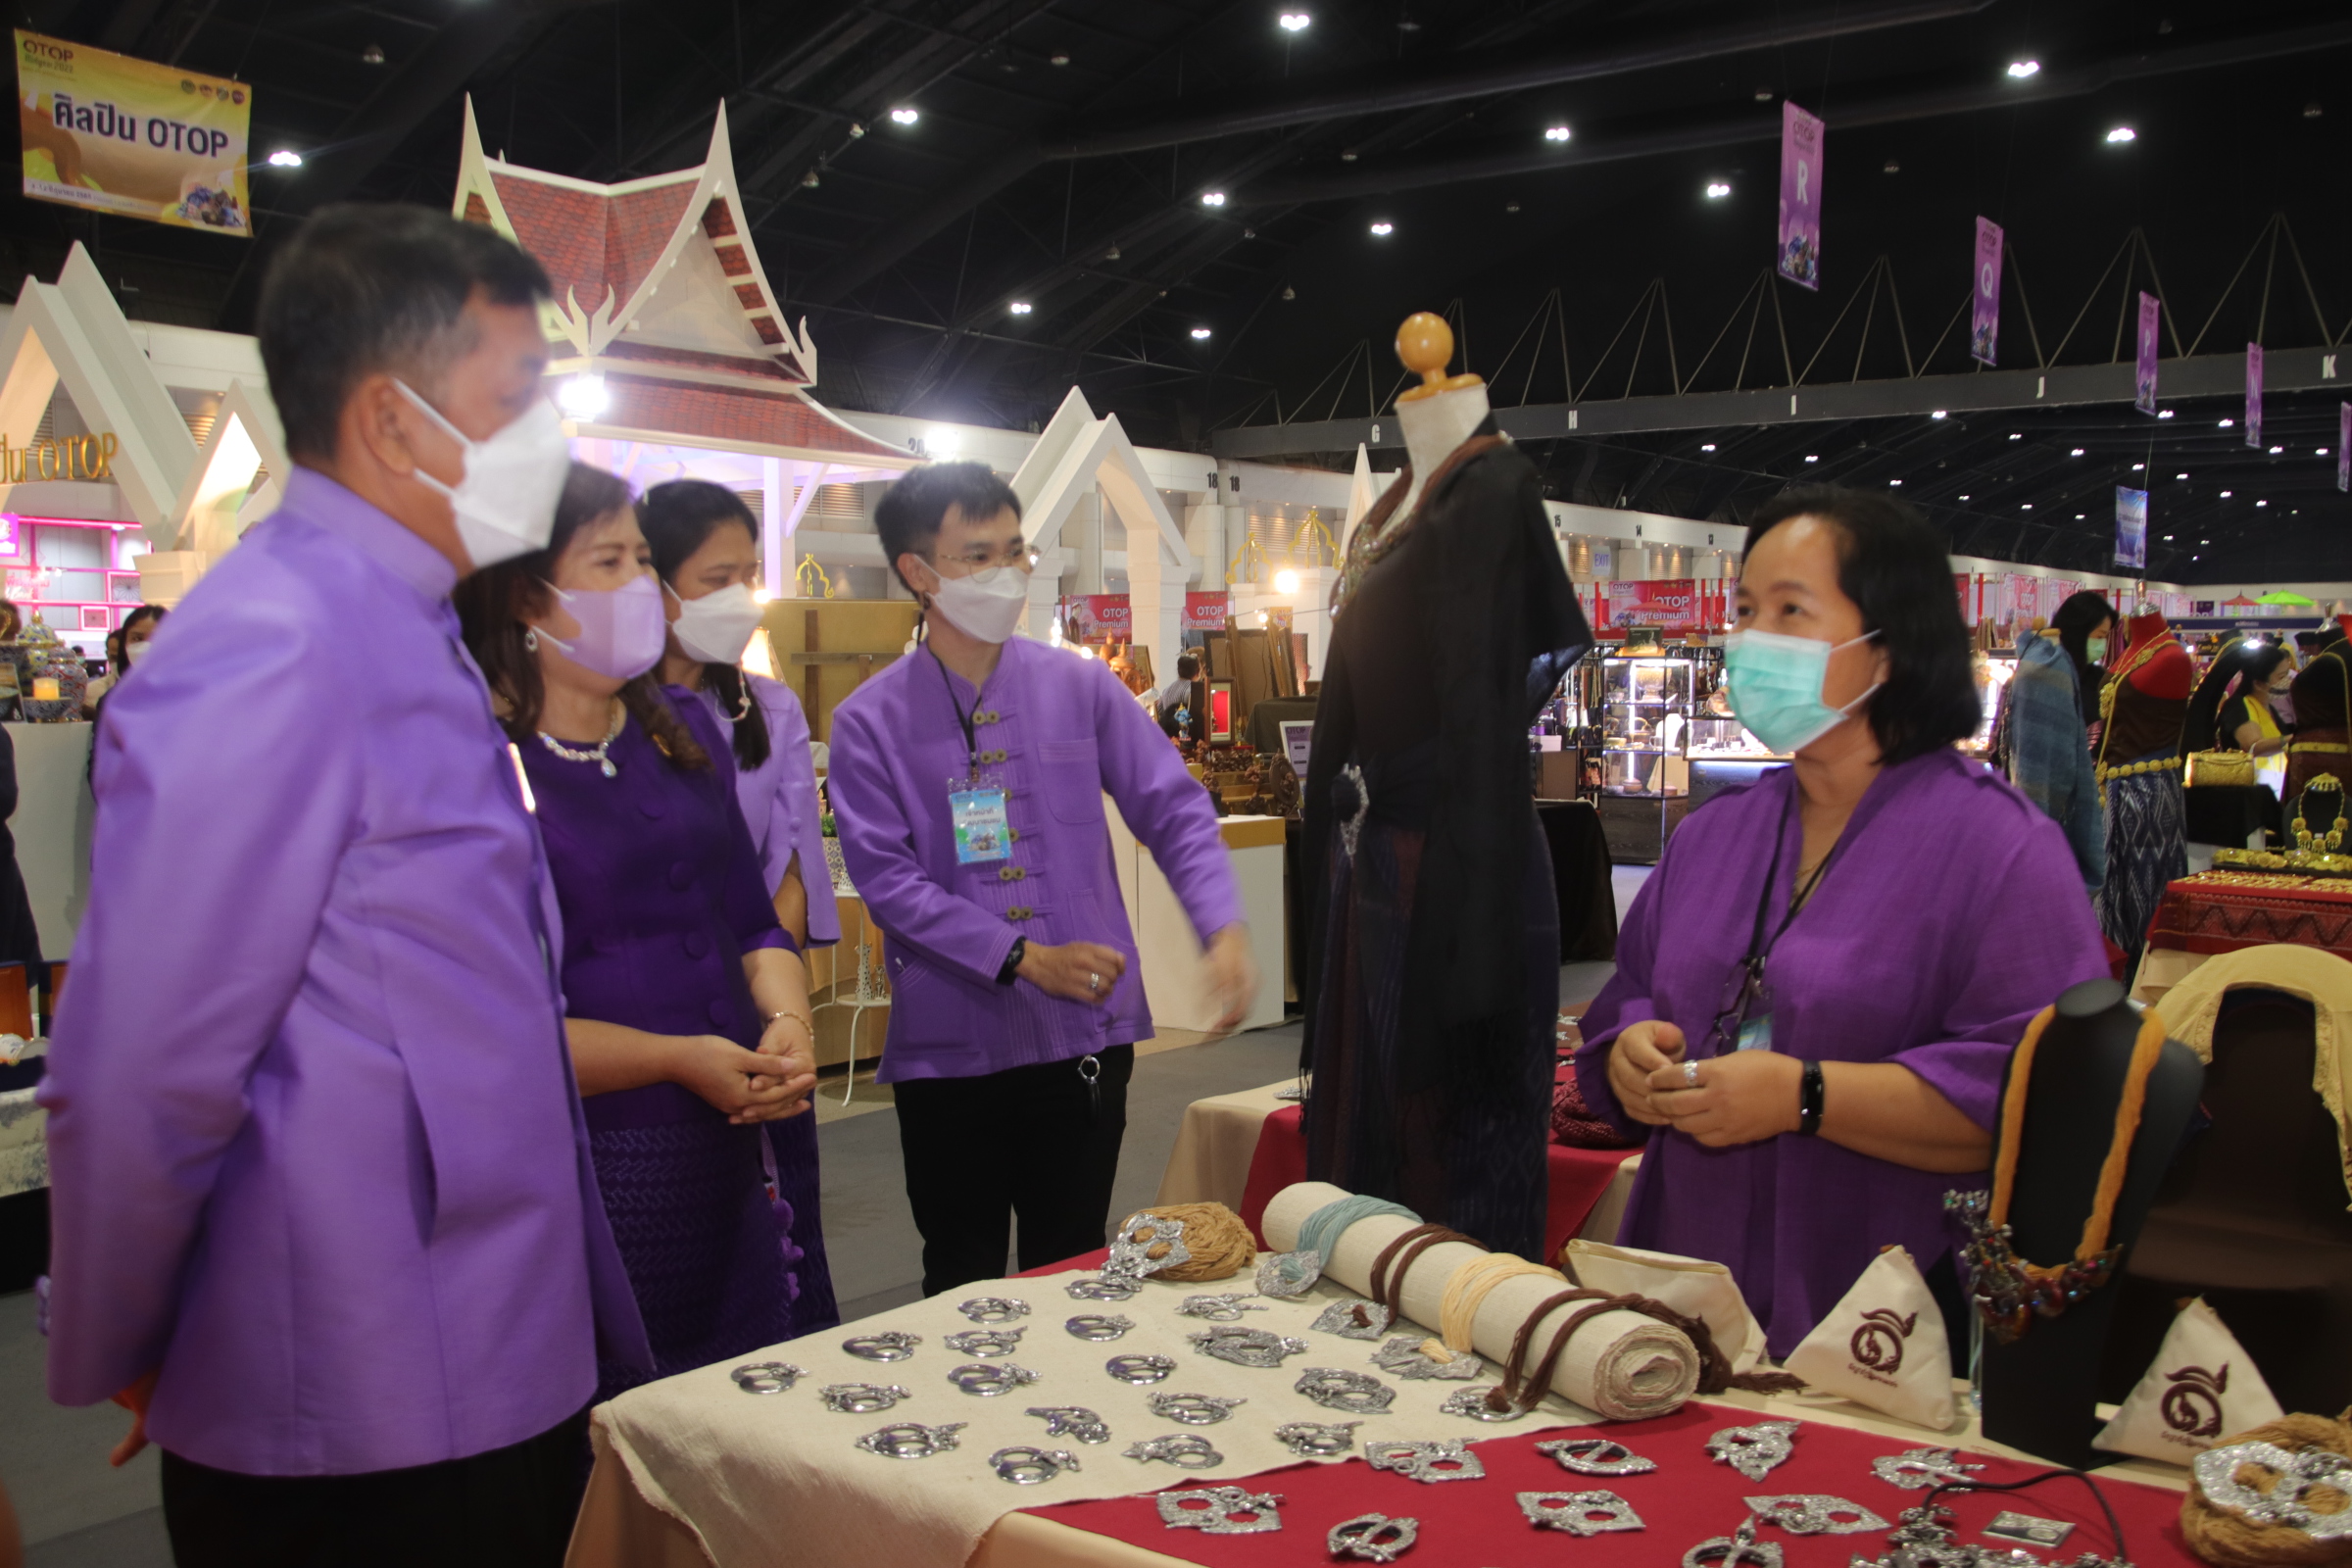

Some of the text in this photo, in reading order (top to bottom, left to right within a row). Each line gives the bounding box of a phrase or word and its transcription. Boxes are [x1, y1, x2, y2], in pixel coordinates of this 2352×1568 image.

[24, 39, 74, 62] OTOP
[54, 93, 229, 158] ศิลปิน OTOP
[1796, 159, 1809, 205] R
[1981, 262, 1993, 299] Q
[2143, 328, 2152, 358] P
[2322, 355, 2337, 379] K
[2035, 376, 2045, 399] J
[1568, 410, 1578, 429] H
[1371, 423, 1381, 443] G
[37, 432, 119, 481] OTOP
[1206, 471, 1218, 489] 18
[1229, 475, 1241, 492] 18
[1594, 553, 1609, 566] EXIT
[1102, 608, 1129, 617] OTOP
[1197, 606, 1224, 616] OTOP
[1641, 611, 1690, 620] Premium
[1094, 619, 1129, 629] Premium
[1187, 617, 1224, 627] Premium
